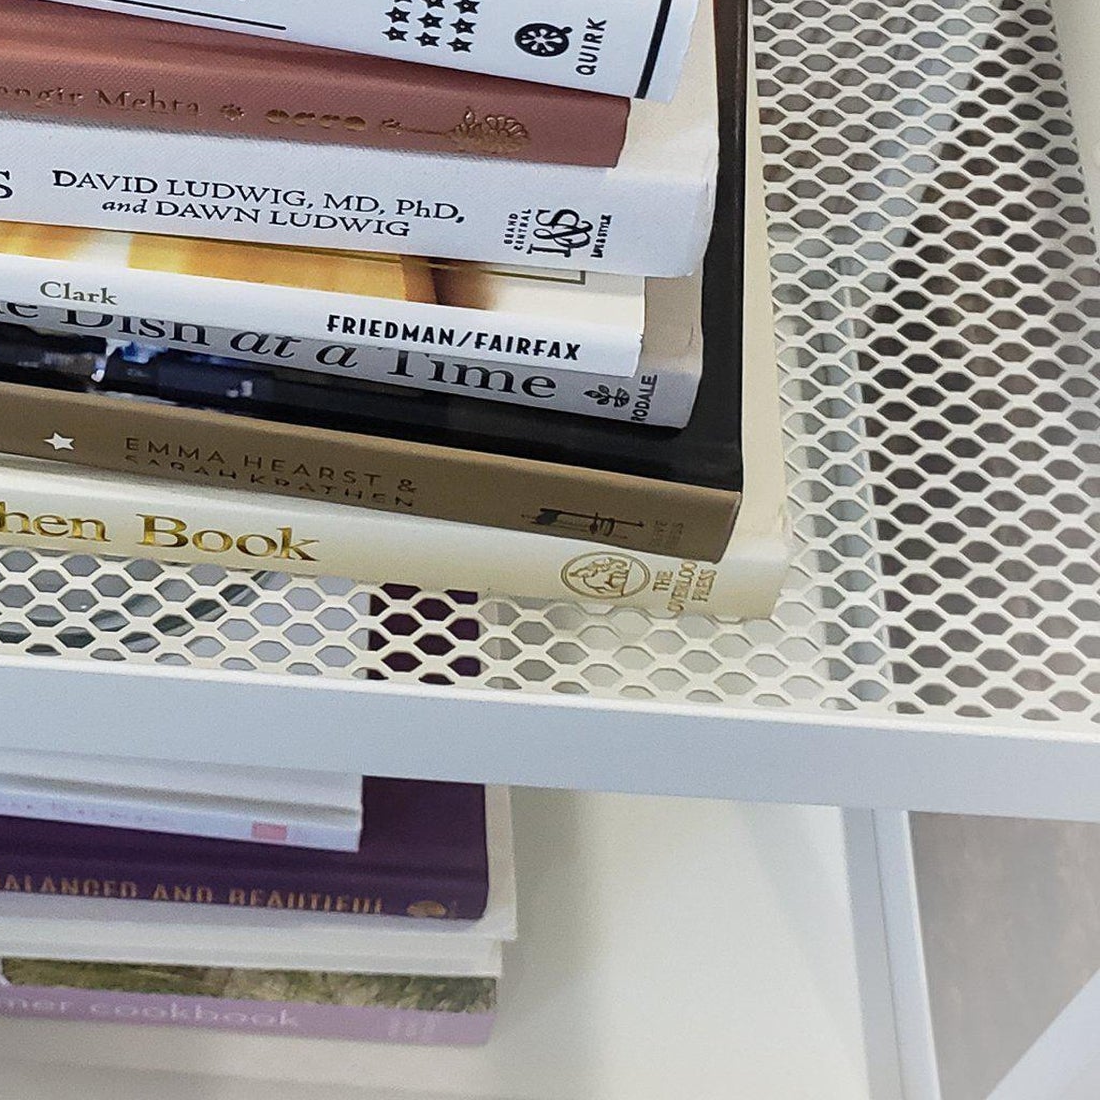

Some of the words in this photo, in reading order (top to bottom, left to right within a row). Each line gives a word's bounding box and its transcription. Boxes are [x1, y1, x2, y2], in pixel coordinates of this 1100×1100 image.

[575, 17, 607, 76] QUIRK
[52, 169, 158, 194] DAVID
[167, 179, 313, 209] LUDWIG,
[323, 193, 386, 215] MD,
[395, 199, 465, 224] PhD,
[102, 199, 148, 214] and
[155, 200, 261, 223] DAWN
[269, 210, 410, 237] LUDWIG
[39, 280, 118, 306] Clark
[230, 331, 302, 359] at
[315, 344, 358, 368] a
[326, 314, 581, 361] FRIEDMAN/FAIRFAX
[125, 437, 226, 464] EMMA
[243, 454, 382, 487] HEARST
[396, 478, 418, 493] &
[134, 513, 321, 562] Book
[89, 1000, 300, 1029] cookbook
